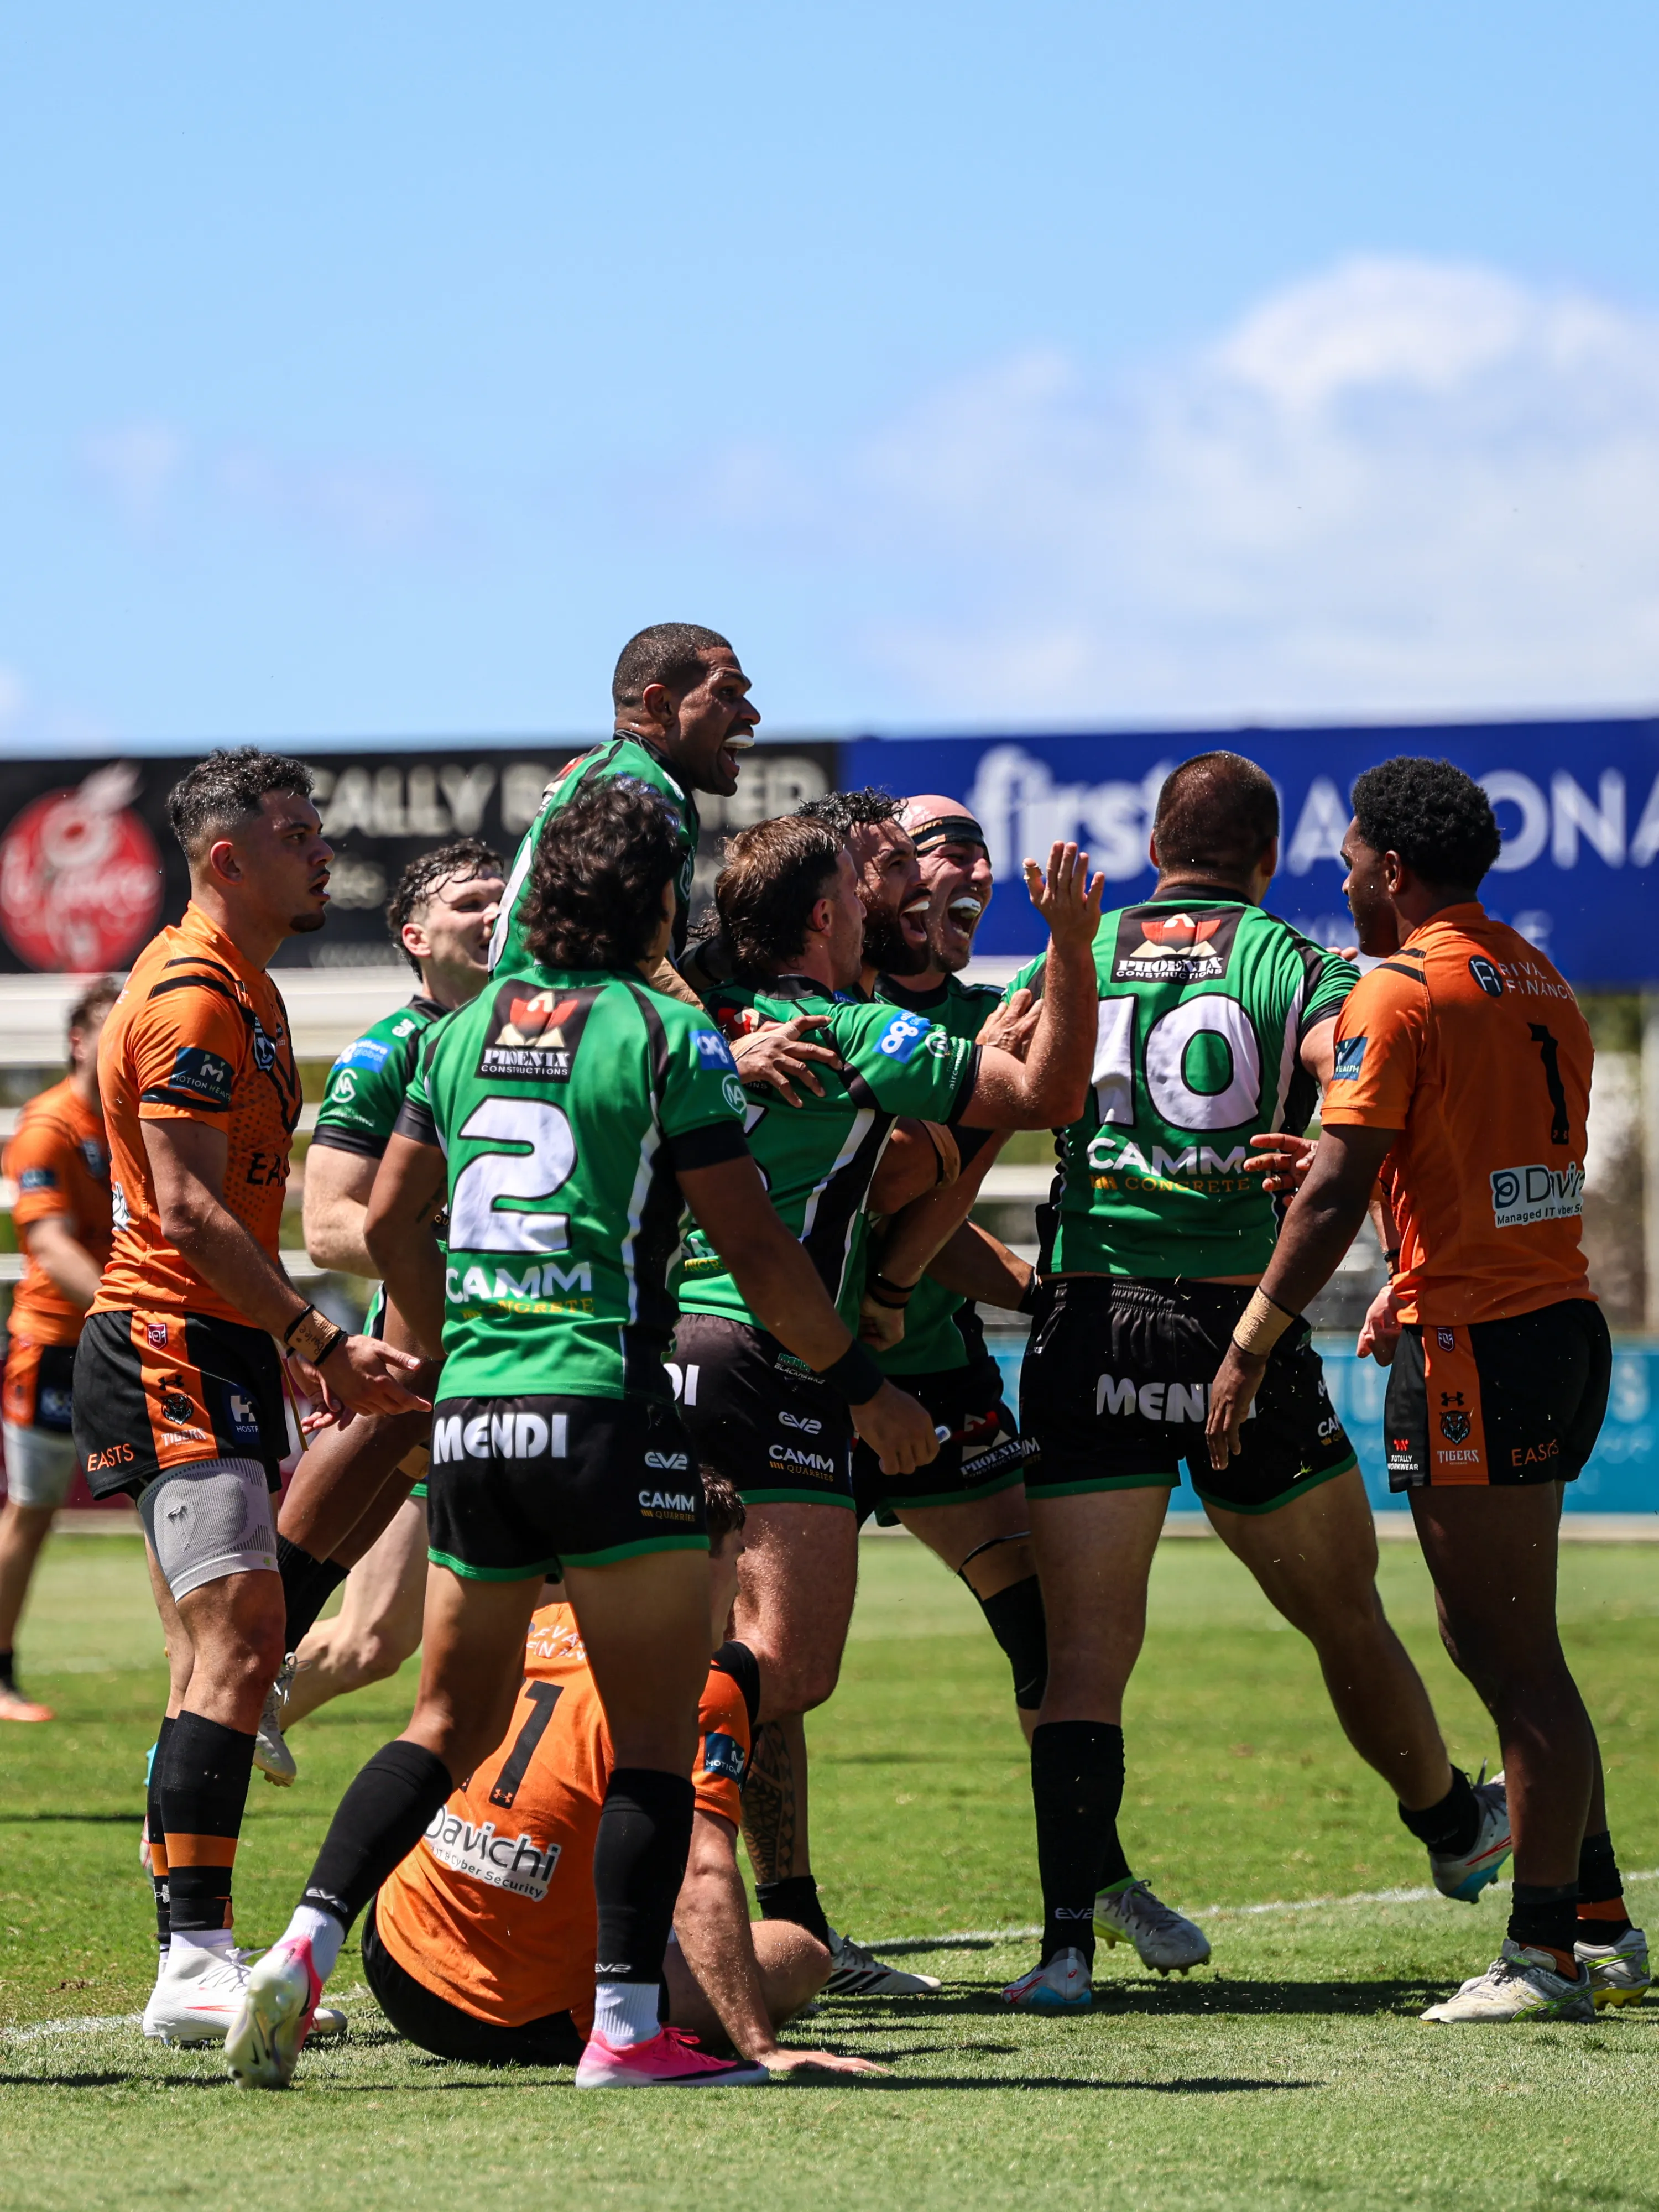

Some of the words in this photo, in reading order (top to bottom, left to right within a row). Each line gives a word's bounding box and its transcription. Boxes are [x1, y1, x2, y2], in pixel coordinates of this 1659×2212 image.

[311, 763, 497, 838] ALLY
[1116, 969, 1223, 980] CONSTRUCTIONS
[1118, 957, 1223, 973] PHOENIX
[481, 1065, 568, 1076] CONSTRUCTIONS
[1091, 993, 1263, 1133] 10
[1087, 1137, 1246, 1177] CAMM
[448, 1095, 578, 1254] 2
[1125, 1177, 1250, 1193] CONCRETE
[1497, 1208, 1542, 1225] Managed
[1545, 1207, 1556, 1217] IT
[446, 1261, 592, 1303] CAMM
[1096, 1373, 1256, 1423] MEN
[160, 1427, 207, 1447] TIGERS
[433, 1413, 567, 1465] MENDI
[87, 1443, 134, 1472] EASTS
[769, 1444, 834, 1473] CAMM
[1391, 1454, 1413, 1463] TOTALLY
[1437, 1449, 1480, 1463] TIGERS
[787, 1464, 834, 1482] QUARRIES
[638, 1491, 695, 1512] CAMM
[655, 1510, 696, 1522] QUARRIES
[489, 1679, 564, 1810] 1
[451, 1854, 482, 1875] Cyber
[484, 1870, 544, 1899] Security
